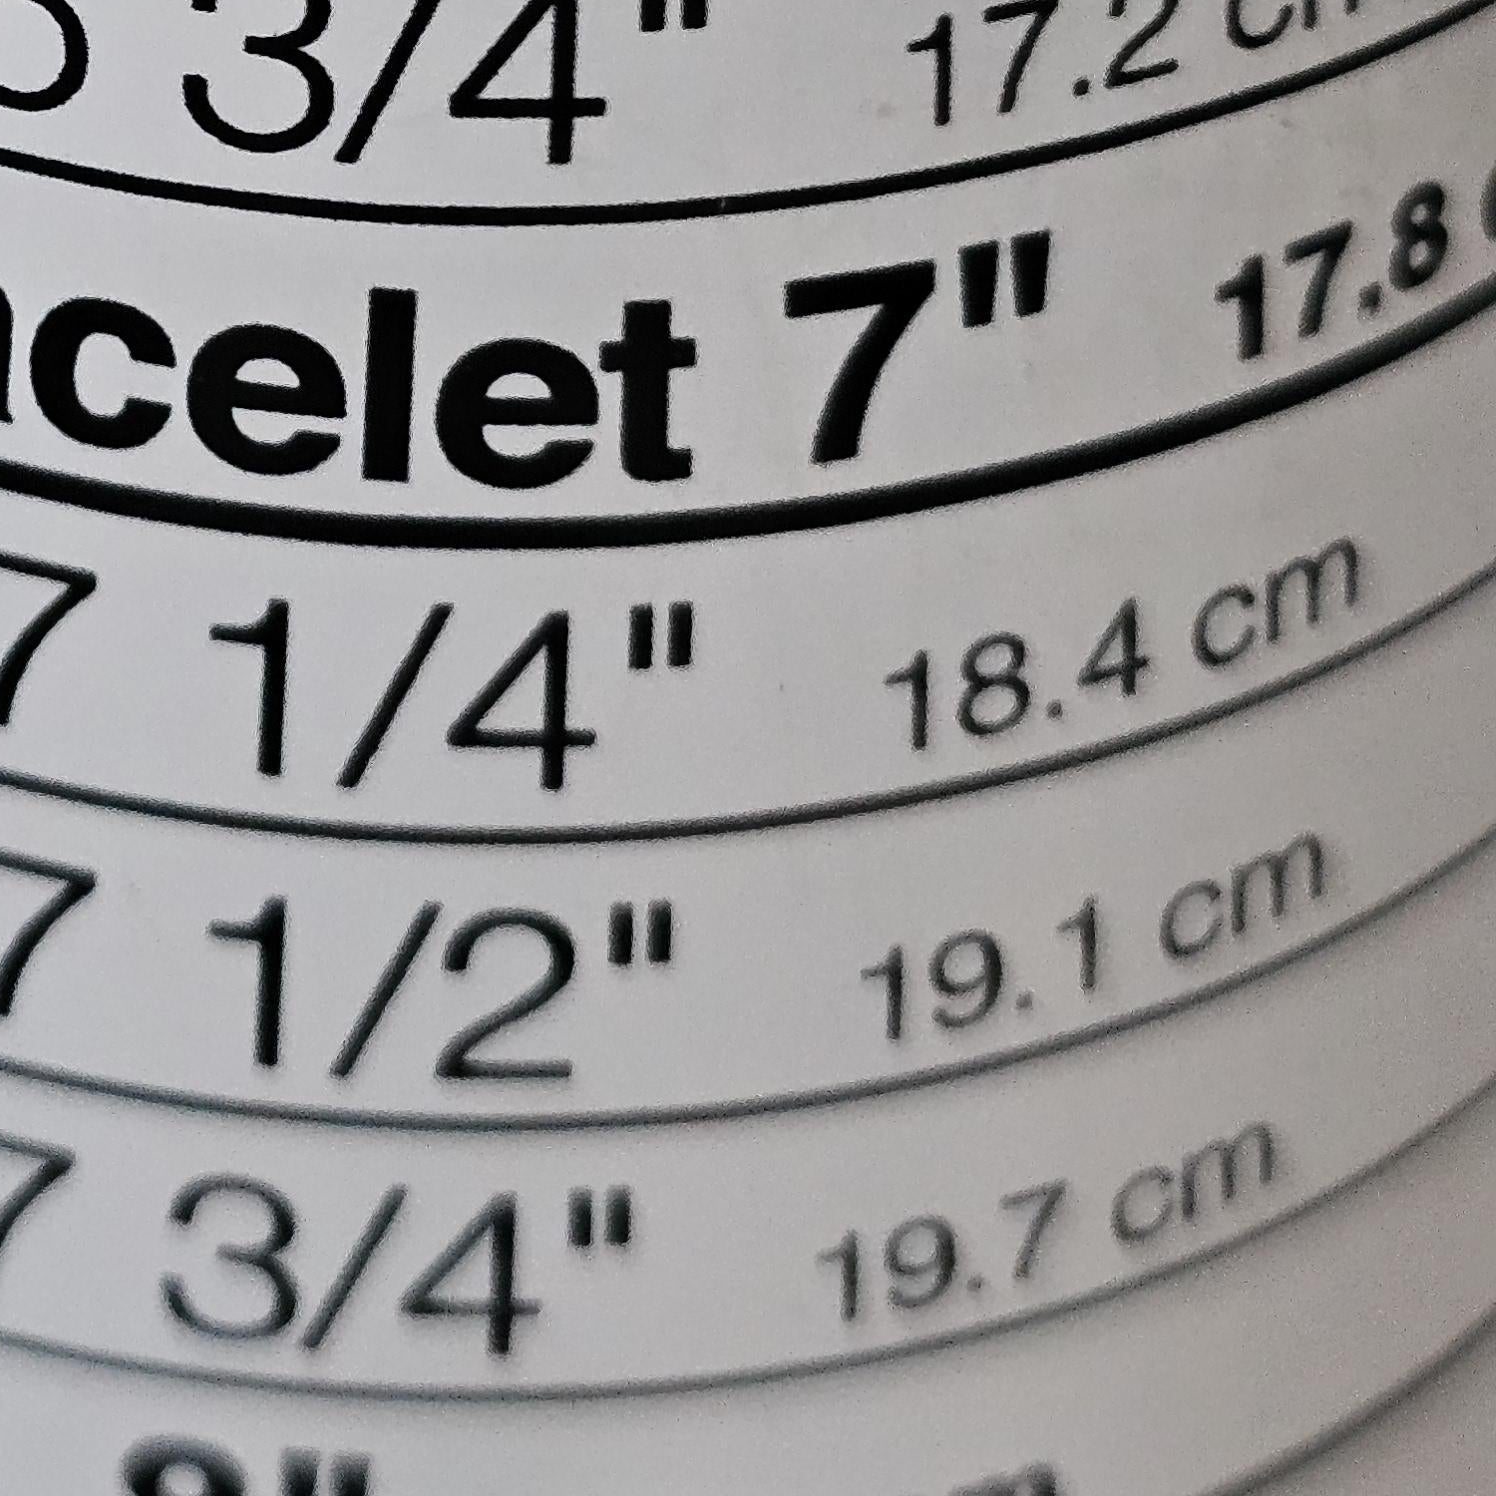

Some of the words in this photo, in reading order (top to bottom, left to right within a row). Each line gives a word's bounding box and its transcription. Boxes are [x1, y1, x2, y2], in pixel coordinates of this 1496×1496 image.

[781, 226, 1055, 470] 7"
[1212, 177, 1457, 365] 17.8
[207, 596, 697, 795] 1/4"
[881, 596, 1153, 754] 18.4
[1189, 537, 1367, 674] cm
[204, 893, 676, 1088] 1/2"
[859, 896, 1103, 1045] 19.1
[1157, 832, 1330, 966] cm
[157, 1172, 636, 1364] 3/4"
[818, 1180, 1068, 1324] 19.7
[1109, 1123, 1281, 1250] cm
